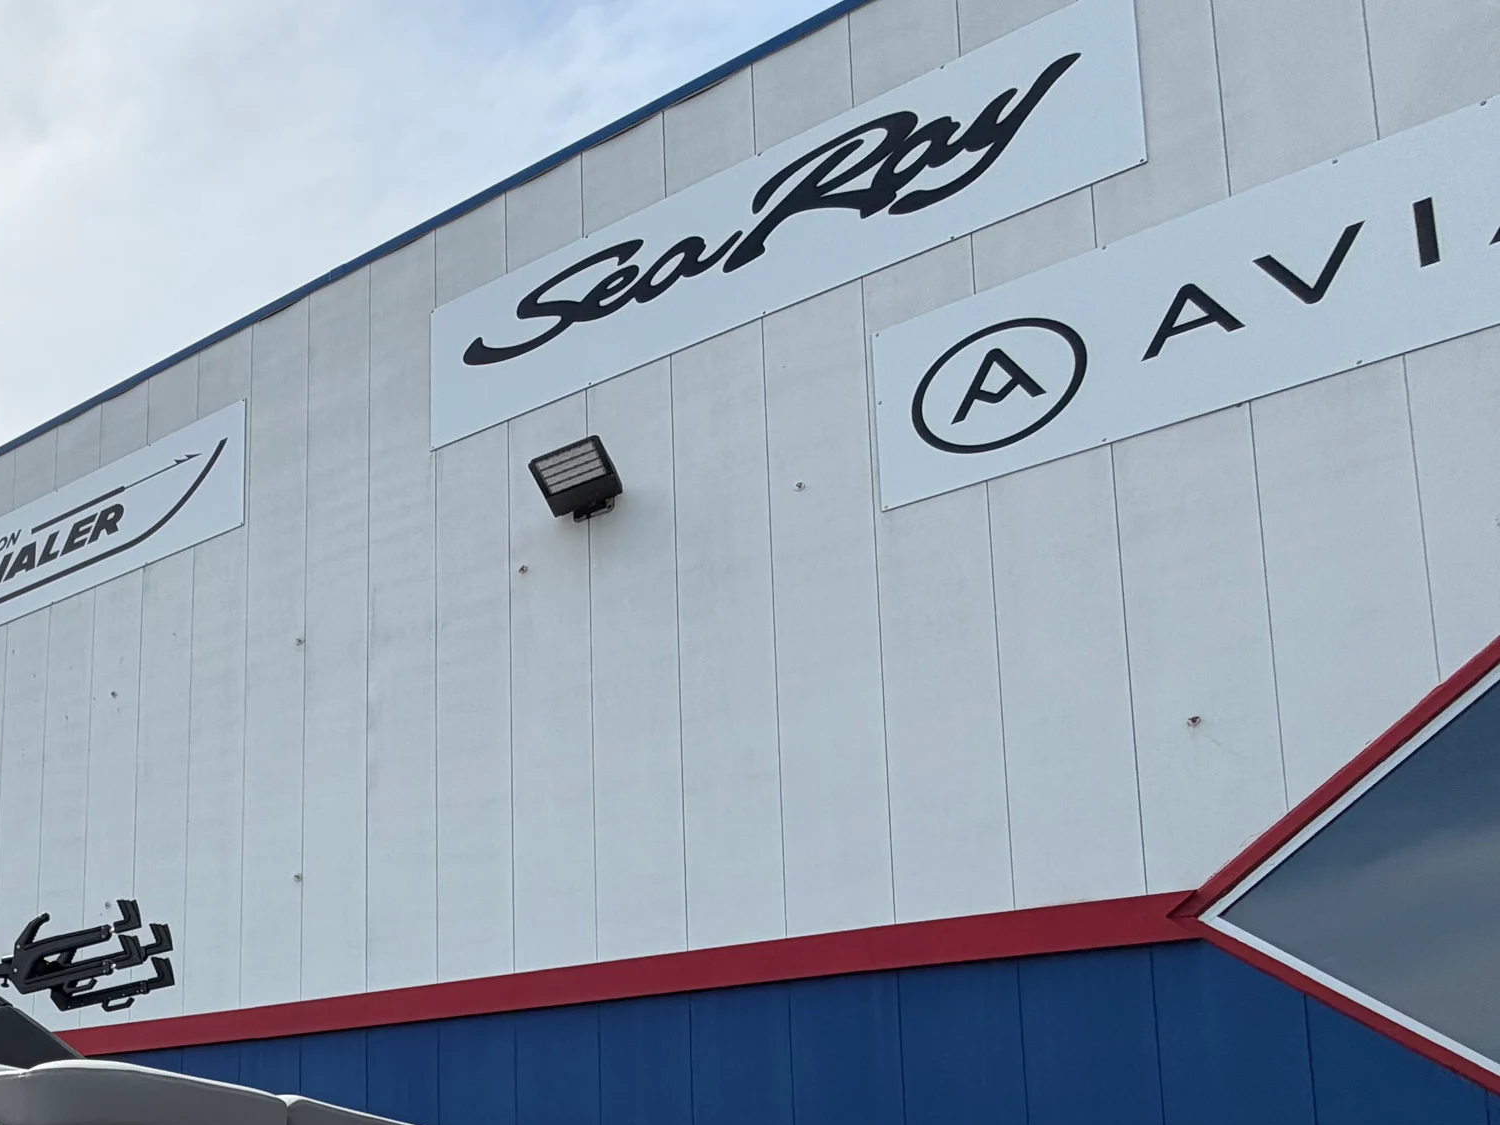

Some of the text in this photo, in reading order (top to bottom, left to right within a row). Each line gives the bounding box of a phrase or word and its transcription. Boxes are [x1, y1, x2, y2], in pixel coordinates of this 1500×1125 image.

[463, 53, 1081, 366] Sea Ray
[1142, 197, 1500, 362] AVI
